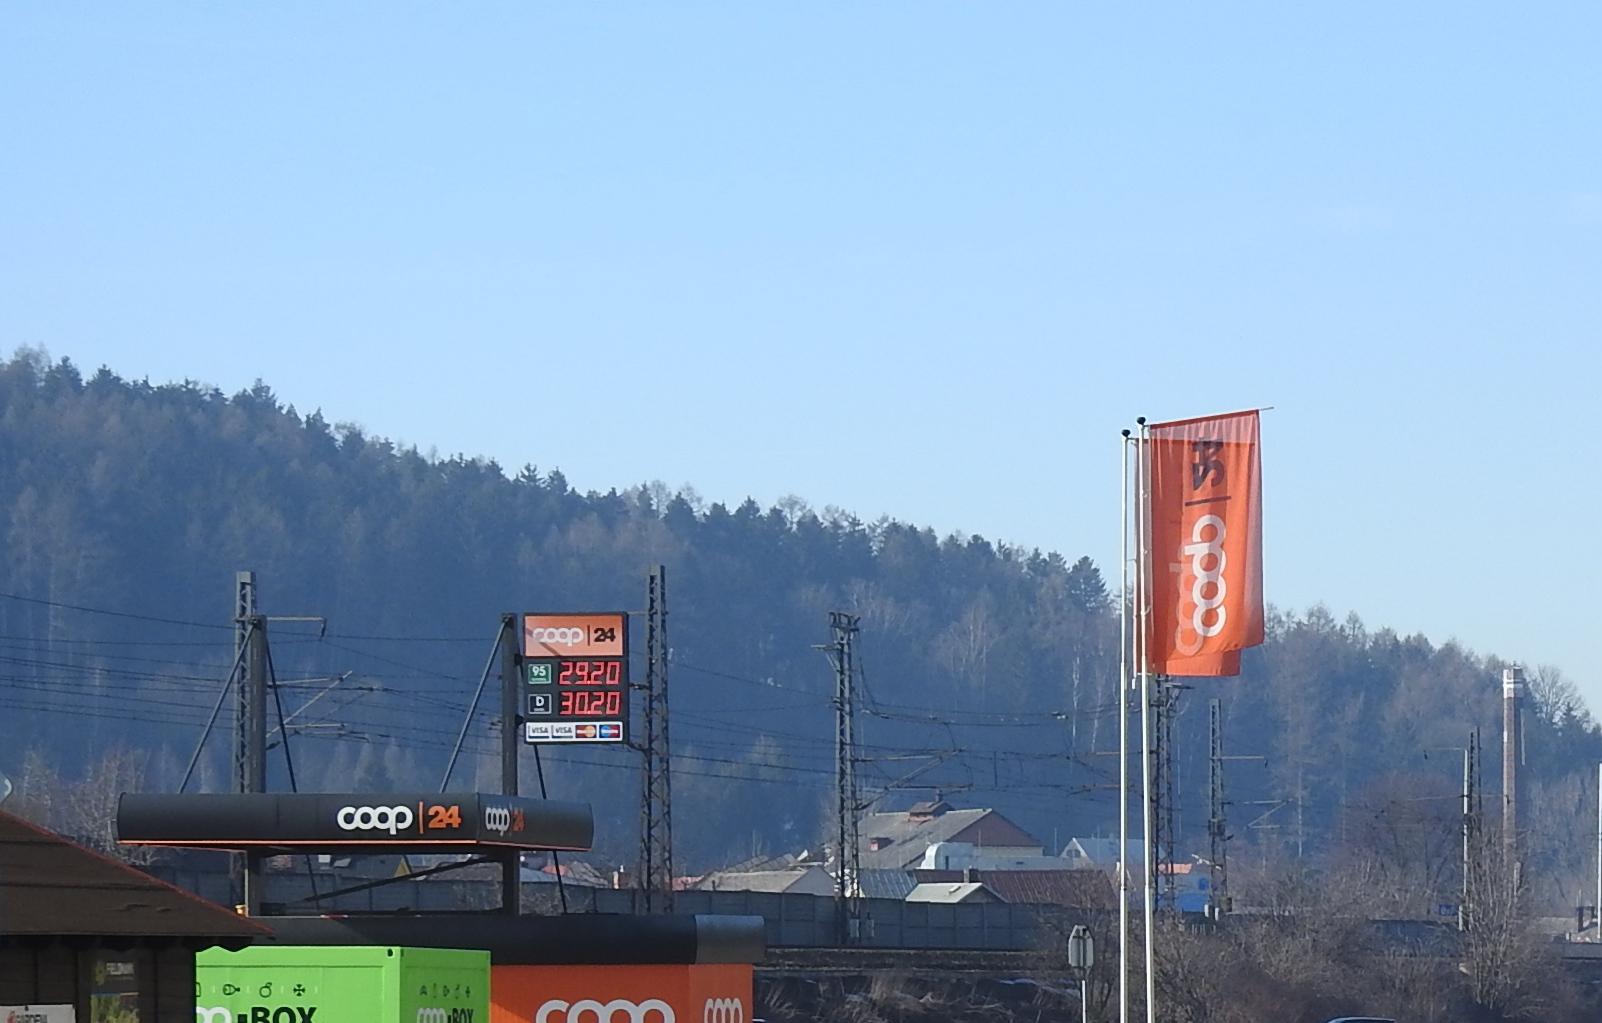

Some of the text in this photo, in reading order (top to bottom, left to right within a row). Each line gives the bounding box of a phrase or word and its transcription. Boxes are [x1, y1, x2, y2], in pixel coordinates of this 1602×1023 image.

[532, 627, 616, 647] coop 24
[532, 661, 620, 685] 95 29.20
[535, 691, 620, 715] D 30.20
[531, 726, 549, 734] VISA
[555, 726, 573, 734] VISA
[337, 805, 461, 835] coop 24
[485, 806, 525, 836] coop 24
